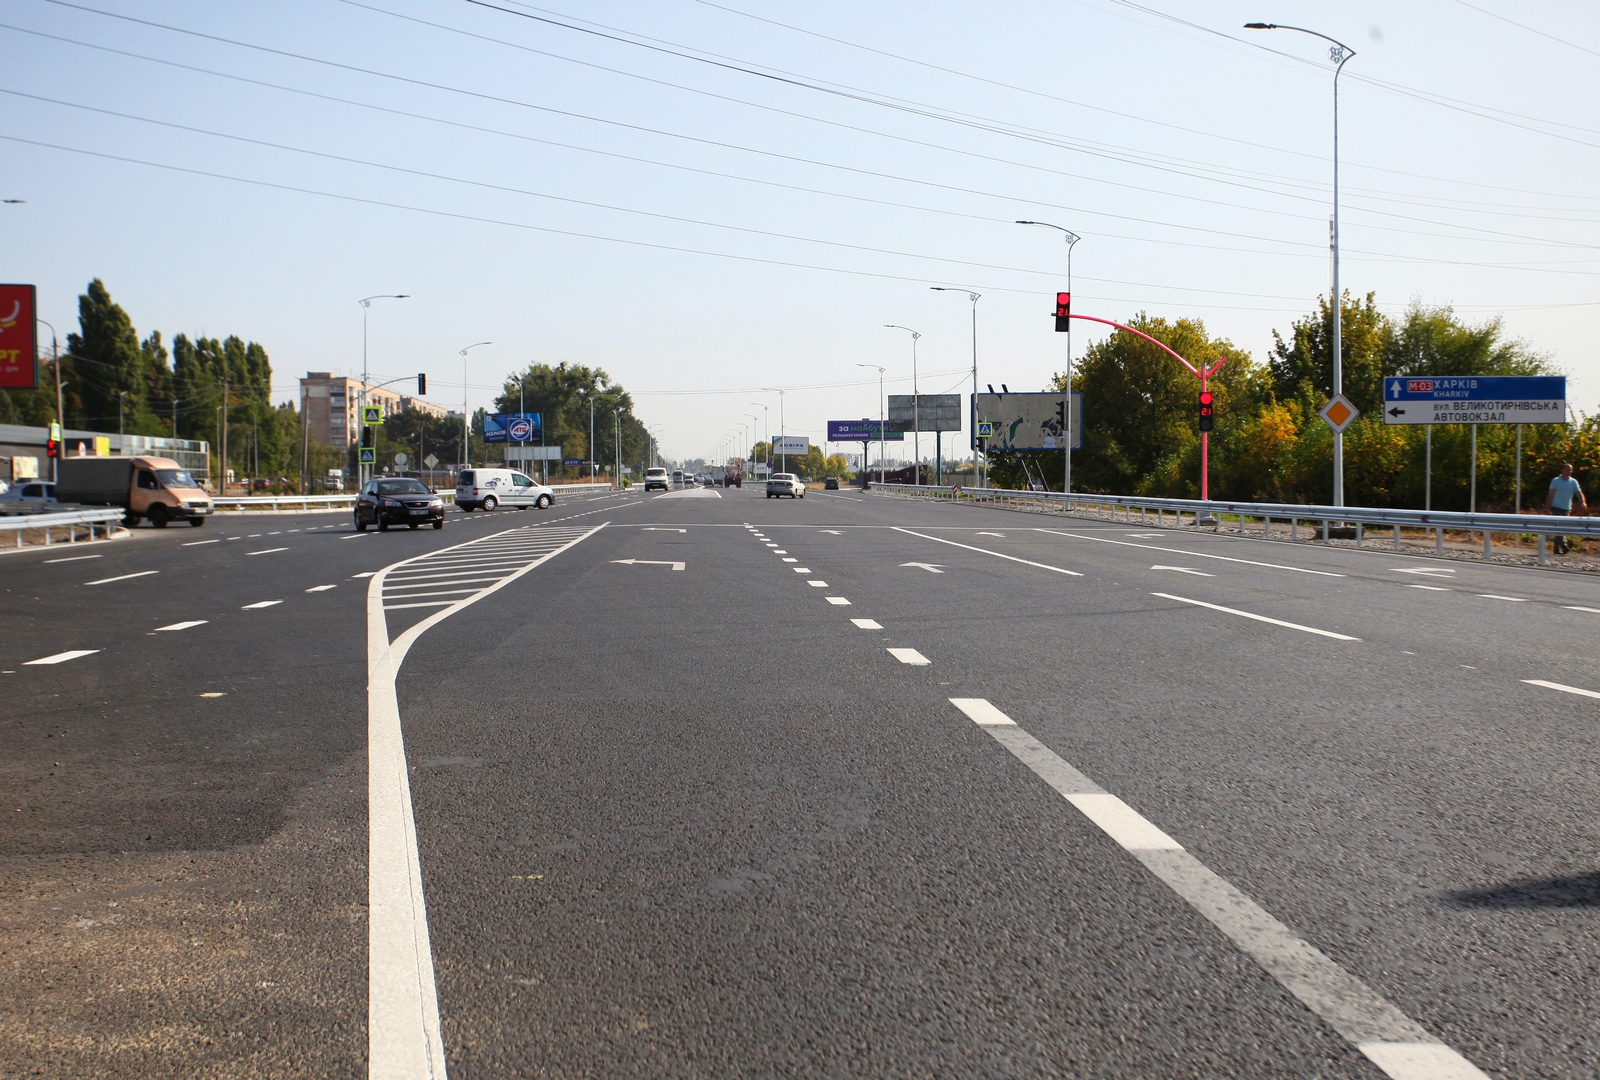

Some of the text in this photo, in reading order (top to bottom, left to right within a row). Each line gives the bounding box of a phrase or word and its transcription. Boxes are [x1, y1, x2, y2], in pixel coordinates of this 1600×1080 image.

[1057, 307, 1069, 317] 21
[1434, 379, 1478, 389] ХАРКІВ
[1433, 390, 1470, 398] KHARKIV
[1453, 401, 1559, 411] ВЕЛИКОТИРНІВСЬКА
[1201, 407, 1212, 416] 21
[1433, 412, 1506, 422] АВТОВОКЗАЛ
[850, 423, 888, 432] майбутн
